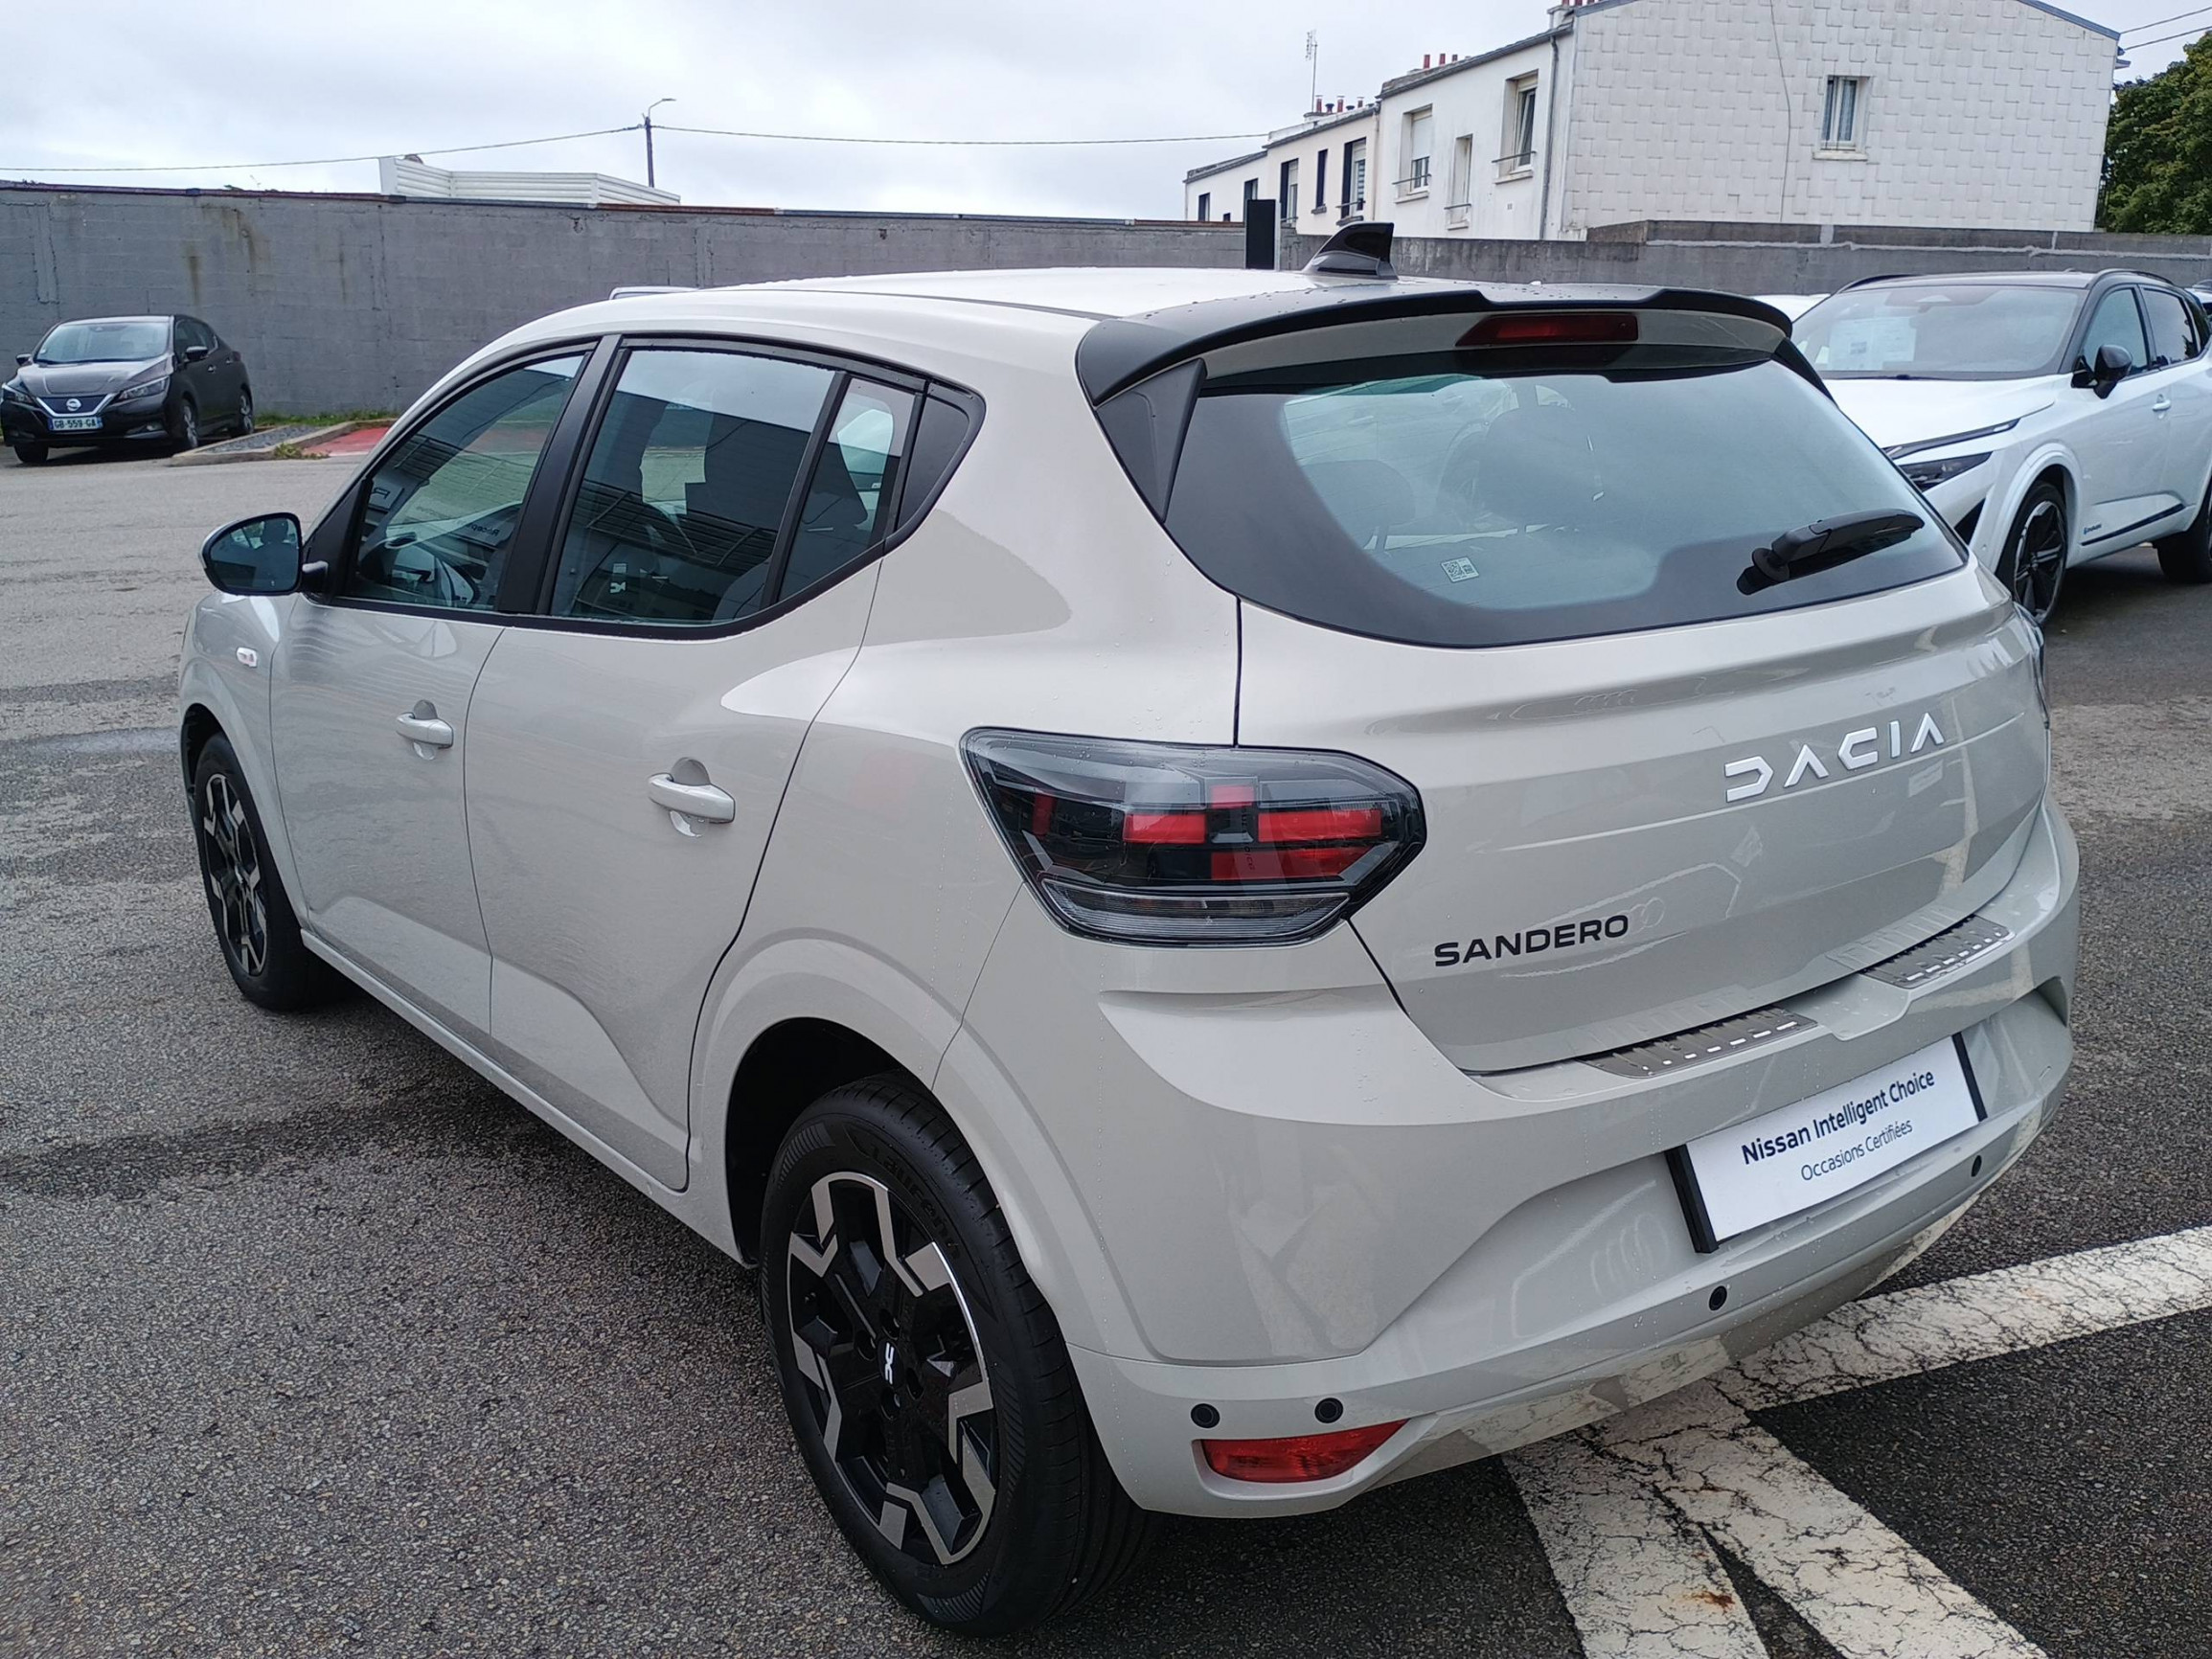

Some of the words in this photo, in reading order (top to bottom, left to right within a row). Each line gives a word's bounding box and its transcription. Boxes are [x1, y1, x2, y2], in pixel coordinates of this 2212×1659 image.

[1724, 712, 1946, 803] DACIA
[1434, 915, 1630, 967] SANDERO
[1742, 1125, 1811, 1165] Nissan
[1813, 1090, 1889, 1138] Intelligent
[1889, 1070, 1935, 1102] Choice
[1801, 1145, 1864, 1181] Occasions
[1865, 1119, 1913, 1151] Certifiées
